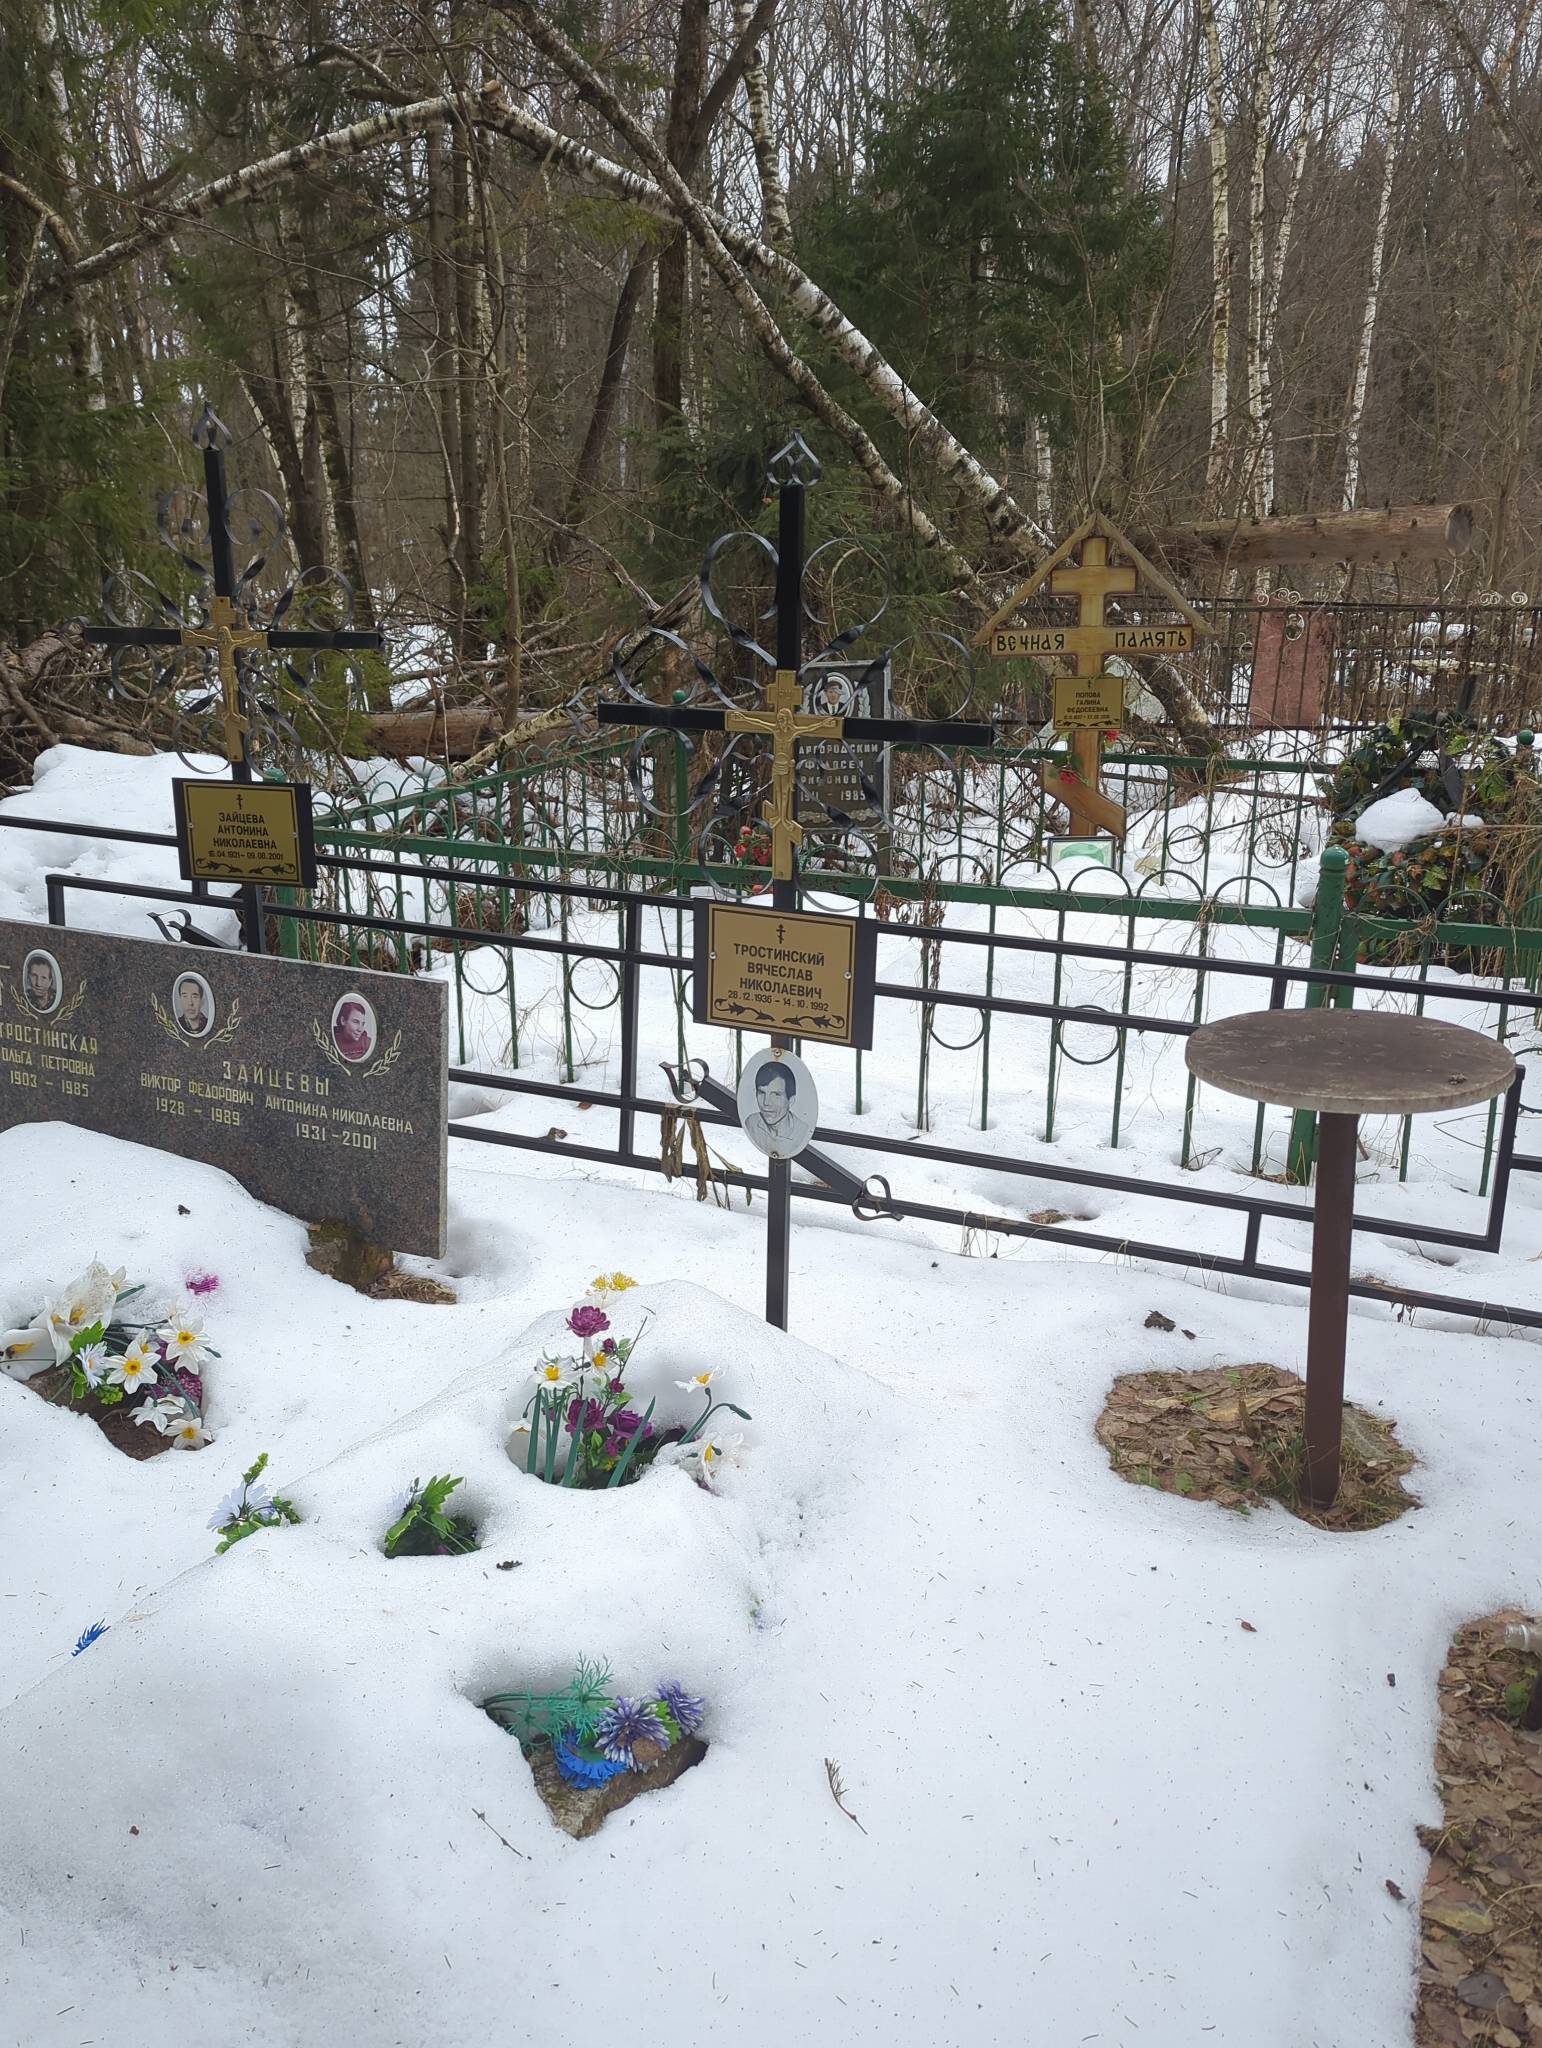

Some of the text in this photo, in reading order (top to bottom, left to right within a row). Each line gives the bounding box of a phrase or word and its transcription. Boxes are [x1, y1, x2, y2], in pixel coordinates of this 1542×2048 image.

[996, 630, 1188, 652] ВЕЧНАЯ ПАМЯТЬ
[840, 790, 866, 801] 1985
[218, 811, 265, 825] ЗАЙЦЕВА
[217, 825, 269, 837] АНТОНИНА
[213, 837, 278, 850] НИКОЛАЕВНА
[733, 943, 825, 967] ТРОСТИНСКИЙ
[747, 961, 814, 982] ВЯЧЕСЛАВ
[739, 977, 823, 1000] НИКОЛАЕВИЧ
[1, 1047, 96, 1077] ОЛЬГА ПЕТРОВНА
[10, 1070, 38, 1088] 1903
[61, 1080, 90, 1098] 1985
[140, 1072, 254, 1106] ВИКТОР ФЕДОРОВИЧ
[222, 1060, 330, 1096] ЗАЙЦЕВЫ
[155, 1097, 185, 1116] 1928
[211, 1108, 241, 1126] 1989
[265, 1095, 414, 1135] АНТОНИНА НИКОЛАЕВНА
[295, 1122, 327, 1142] 1931
[342, 1130, 377, 1151] 2001
